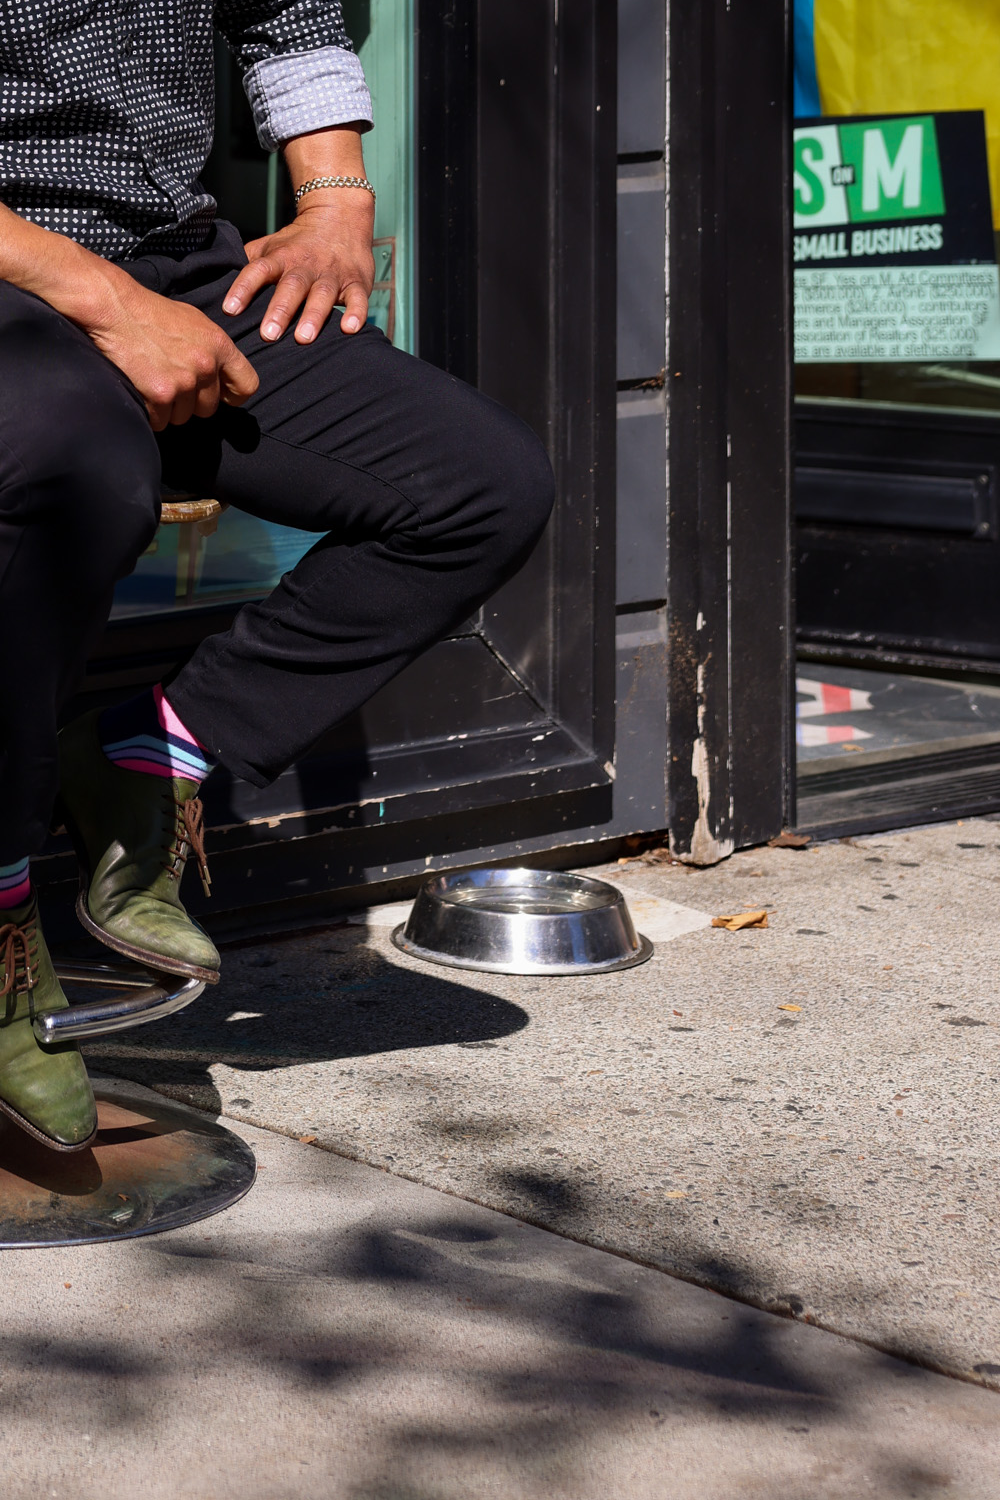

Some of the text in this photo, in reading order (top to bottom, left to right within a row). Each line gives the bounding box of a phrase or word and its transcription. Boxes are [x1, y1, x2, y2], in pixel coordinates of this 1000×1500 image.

[862, 124, 924, 212] M
[851, 224, 943, 257] BUSINESS
[812, 346, 830, 357] are
[834, 344, 884, 357] available
